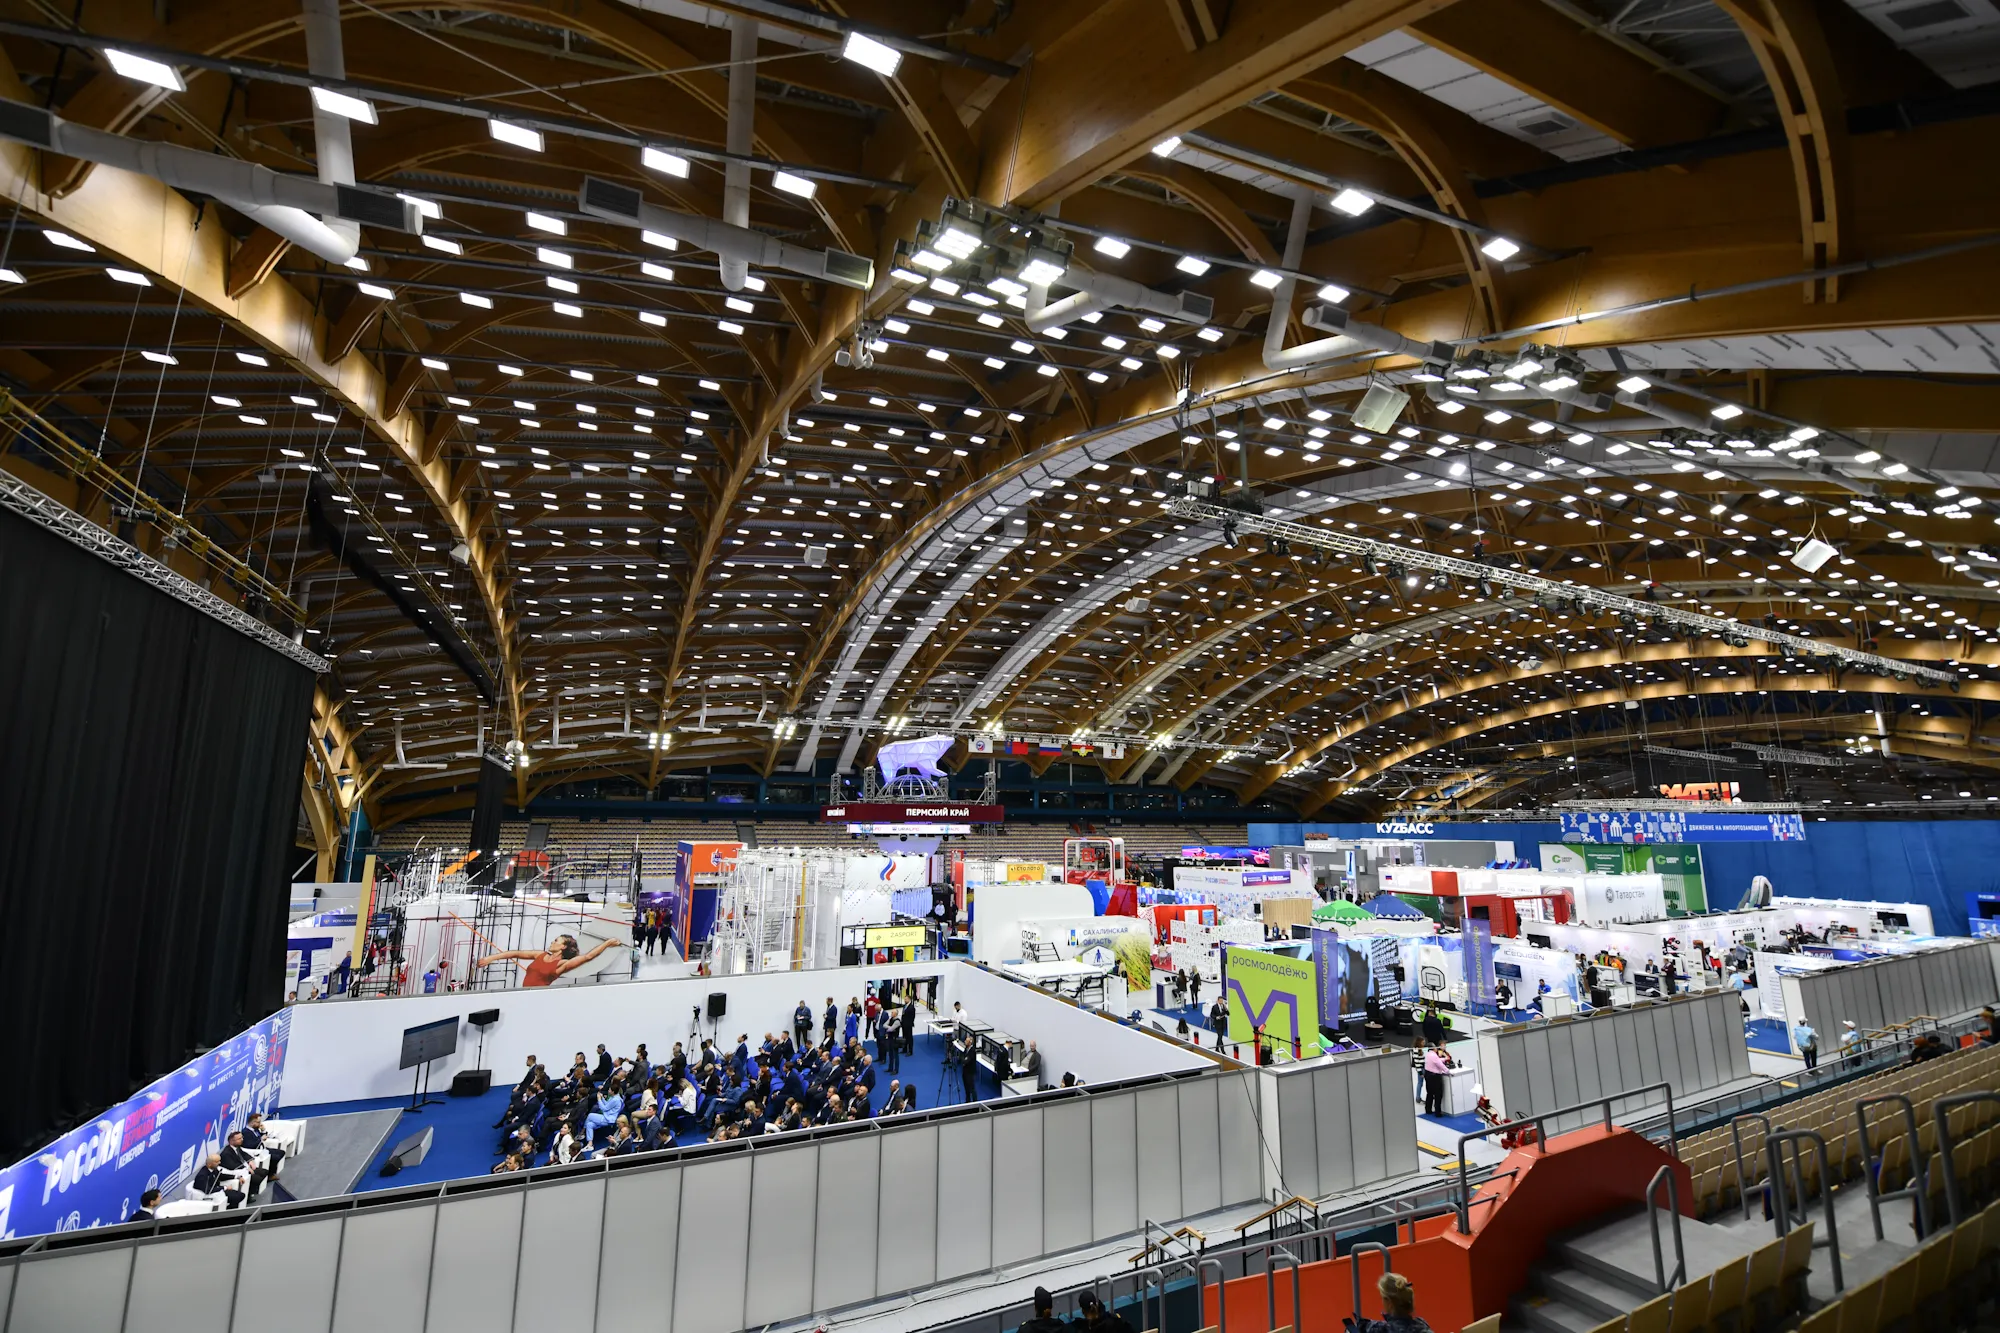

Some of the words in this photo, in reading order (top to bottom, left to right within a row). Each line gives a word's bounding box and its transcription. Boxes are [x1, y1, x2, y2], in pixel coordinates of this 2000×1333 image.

[906, 807, 948, 816] ПЕРМСКИЙ
[950, 807, 969, 816] КРАЙ
[1376, 823, 1434, 834] КУZБАСС
[1615, 890, 1646, 900] Татарстан
[1083, 927, 1128, 936] САХАЛИНСКАЯ
[1083, 938, 1112, 946] ОБЛАСТЬ
[1232, 956, 1308, 980] росмолодёжь
[42, 1118, 125, 1206] РОССИЯ
